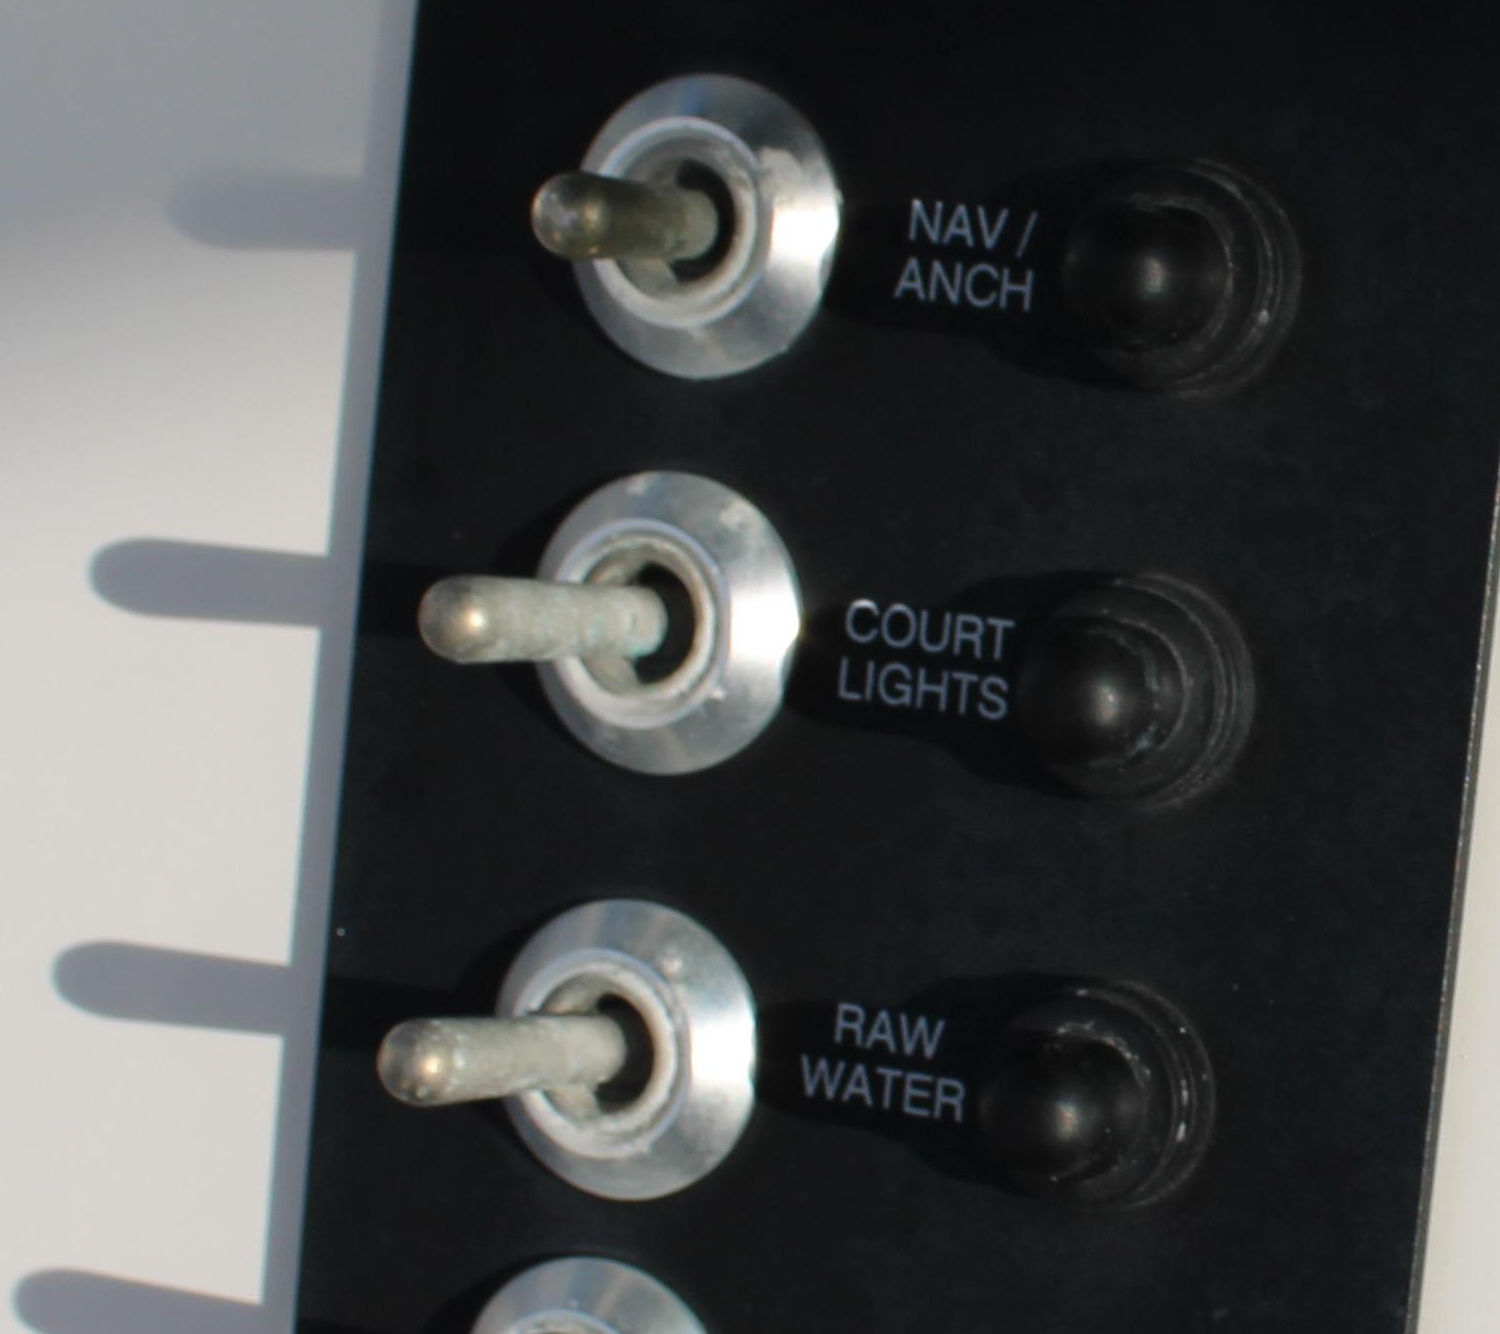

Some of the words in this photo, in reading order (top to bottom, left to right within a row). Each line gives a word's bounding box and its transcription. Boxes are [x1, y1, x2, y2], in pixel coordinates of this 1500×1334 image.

[895, 258, 1033, 311] ANCH
[843, 599, 1015, 660] COURT
[838, 661, 1008, 721] LIGHTS
[835, 1002, 946, 1059] RAW
[802, 1060, 966, 1122] WATER
